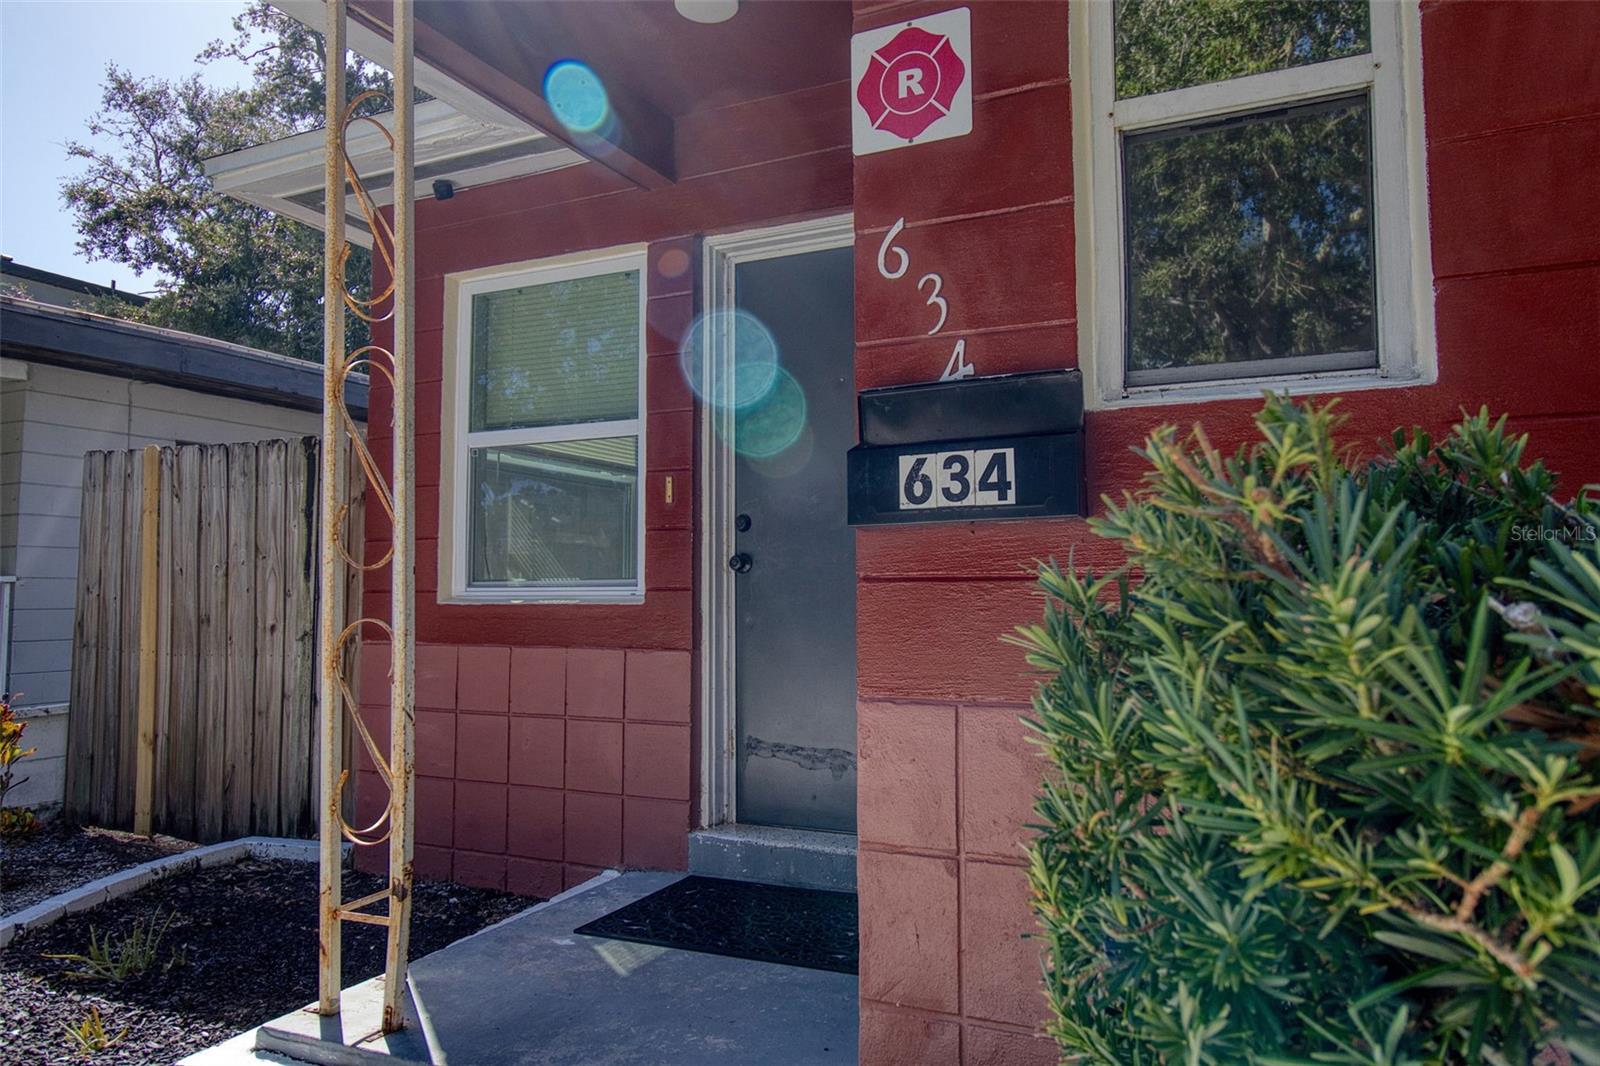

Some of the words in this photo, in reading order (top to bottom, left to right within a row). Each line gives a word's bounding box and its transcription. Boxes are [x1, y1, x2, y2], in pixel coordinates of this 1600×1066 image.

[898, 68, 925, 99] R
[877, 216, 975, 382] 634
[903, 451, 1012, 505] 634
